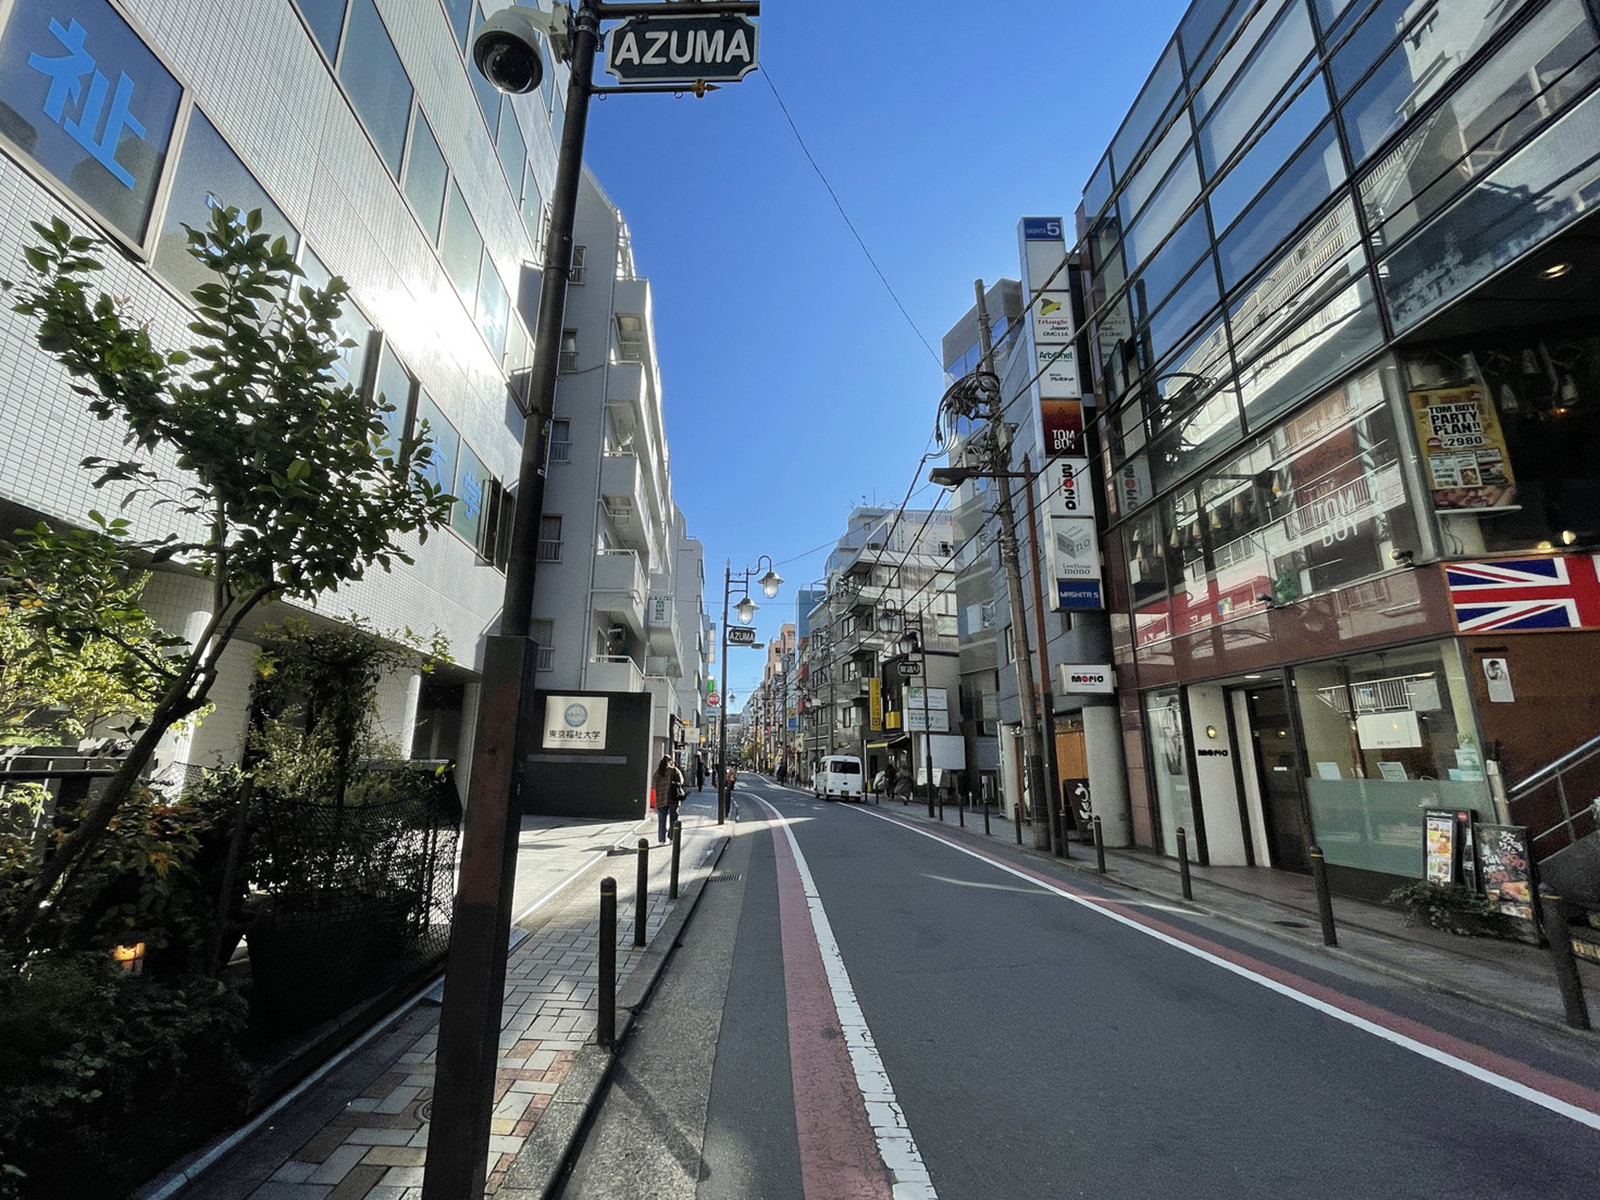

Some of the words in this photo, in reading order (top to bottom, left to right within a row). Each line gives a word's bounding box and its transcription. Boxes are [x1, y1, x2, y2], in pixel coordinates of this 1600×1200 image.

[614, 29, 751, 66] AZUMA
[27, 16, 147, 191] 祉
[1046, 222, 1061, 236] 5
[1428, 405, 1453, 415] TOM
[1454, 402, 1476, 412] BOY
[1430, 411, 1478, 426] PARTY
[1052, 429, 1075, 440] TOM
[1314, 489, 1357, 523] TOM
[729, 632, 755, 642] AZUMA
[549, 730, 601, 740] 東京福祉大学
